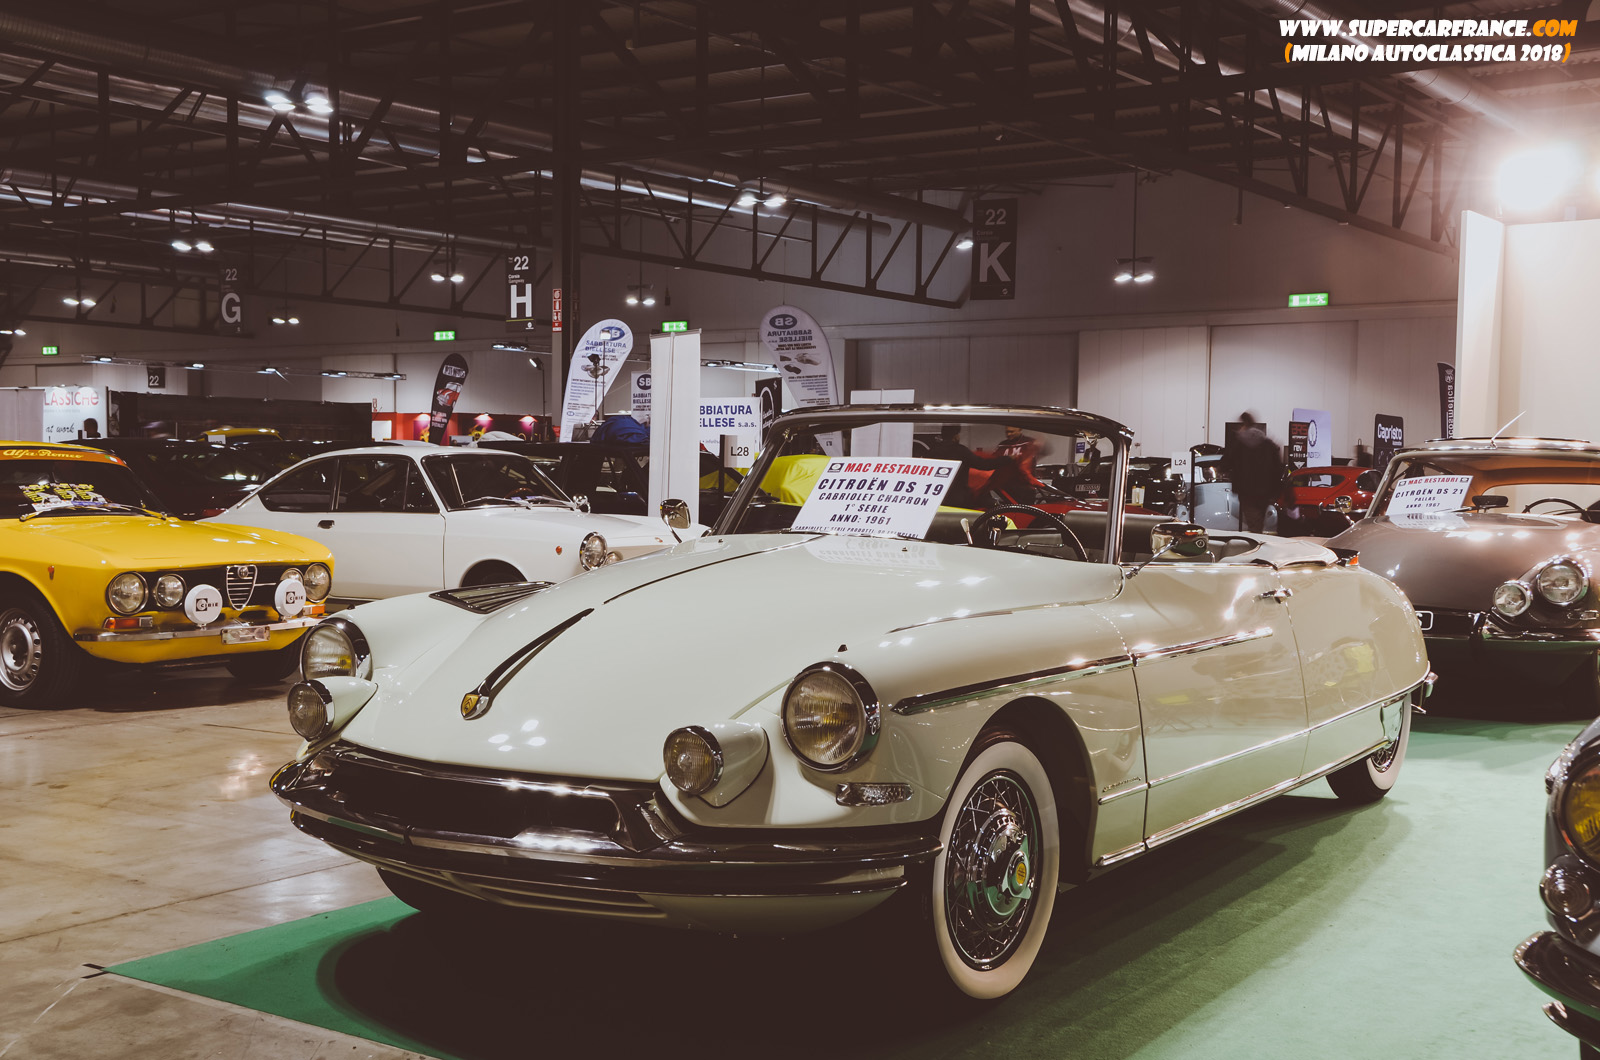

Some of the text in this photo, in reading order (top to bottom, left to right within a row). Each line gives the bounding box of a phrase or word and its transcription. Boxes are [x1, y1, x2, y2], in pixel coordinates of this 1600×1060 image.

[985, 208, 1007, 226] 22
[514, 256, 529, 270] 22
[979, 241, 1011, 282] K
[225, 268, 238, 281] 22
[510, 283, 532, 318] H
[221, 292, 241, 324] G
[149, 375, 159, 386] 22
[1377, 423, 1403, 442] Capristo
[3, 449, 84, 459] Alfa Romeo
[730, 446, 749, 456] L28
[844, 462, 935, 477] MAC RESTAURI
[818, 477, 944, 496] CITROËN DS 19
[818, 492, 930, 506] CABRIOLET CHAPRON
[858, 504, 889, 514] SERIE
[829, 514, 892, 526] ANNO: 1961
